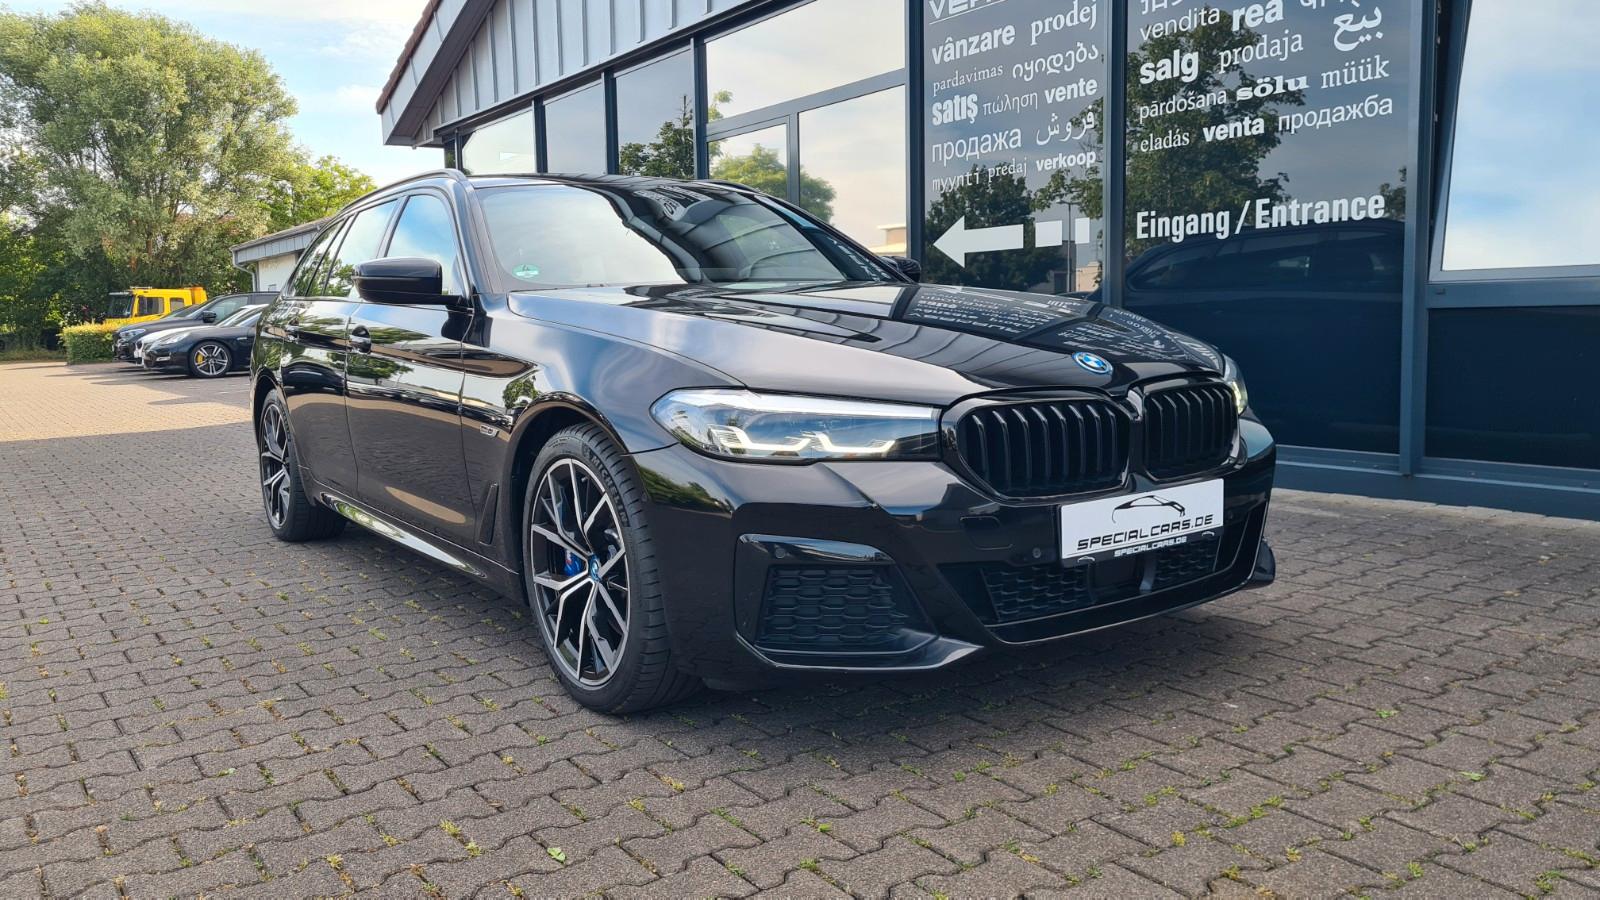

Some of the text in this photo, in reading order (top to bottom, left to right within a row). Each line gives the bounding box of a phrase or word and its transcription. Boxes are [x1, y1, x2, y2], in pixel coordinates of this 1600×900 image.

[932, 0, 1098, 65] vânzare prodej
[1140, 7, 1220, 41] vendita
[1232, 0, 1284, 32] rea
[1333, 6, 1384, 52] بيع
[933, 42, 1099, 97] pardavimas იყიდება
[1140, 29, 1304, 84] salg prodaja
[932, 78, 1098, 126] satış πώληση vente
[1139, 54, 1390, 125] pārdošana sölu müük
[932, 105, 1095, 167] продажа فروش
[1140, 94, 1393, 152] eladás venta продажба
[932, 151, 1097, 194] myynti predaj verkoop
[590, 455, 628, 523] MICHELIN
[1077, 514, 1214, 551] SPECIALCARS.DE
[1114, 536, 1187, 557] SPECIALCARS.DE
